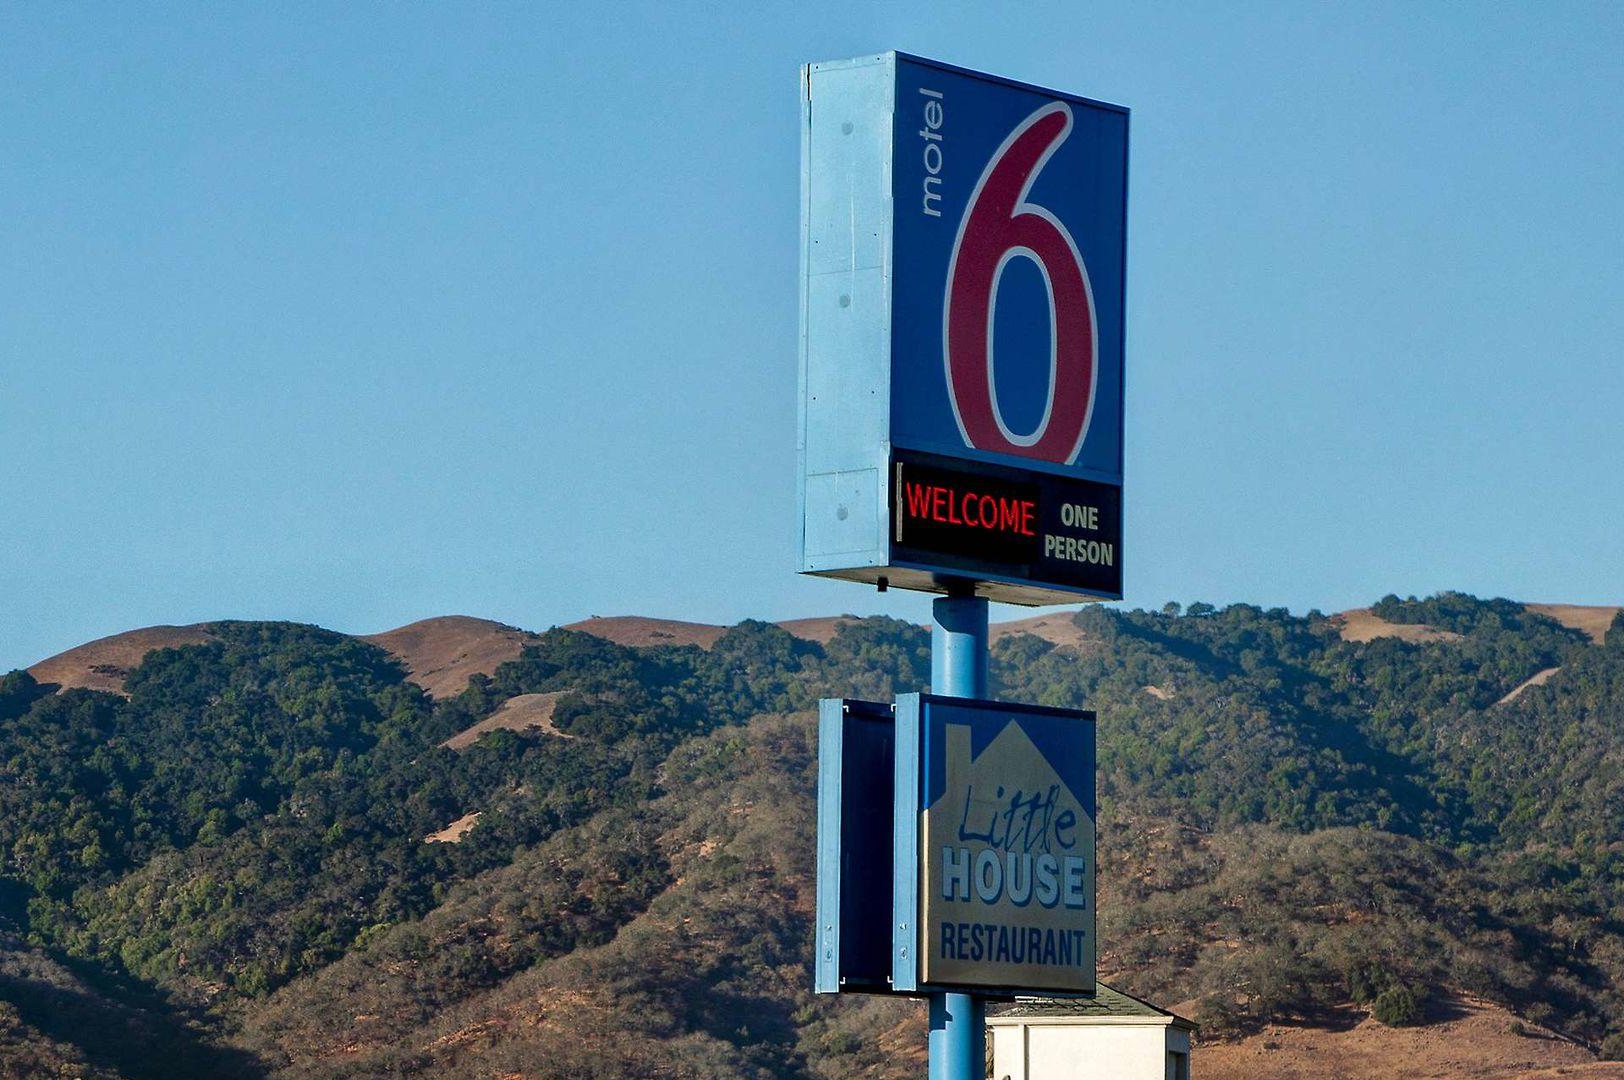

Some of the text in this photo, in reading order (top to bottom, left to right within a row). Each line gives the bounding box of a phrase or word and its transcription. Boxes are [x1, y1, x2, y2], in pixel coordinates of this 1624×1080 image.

[919, 87, 944, 217] motel
[943, 100, 1099, 465] 6
[906, 481, 1035, 536] WELCOME
[1060, 503, 1098, 530] ONE
[1044, 534, 1113, 567] PERSON
[958, 784, 1077, 853] Little
[941, 846, 1086, 910] HOUSE
[941, 922, 1086, 967] RESTAURANT
